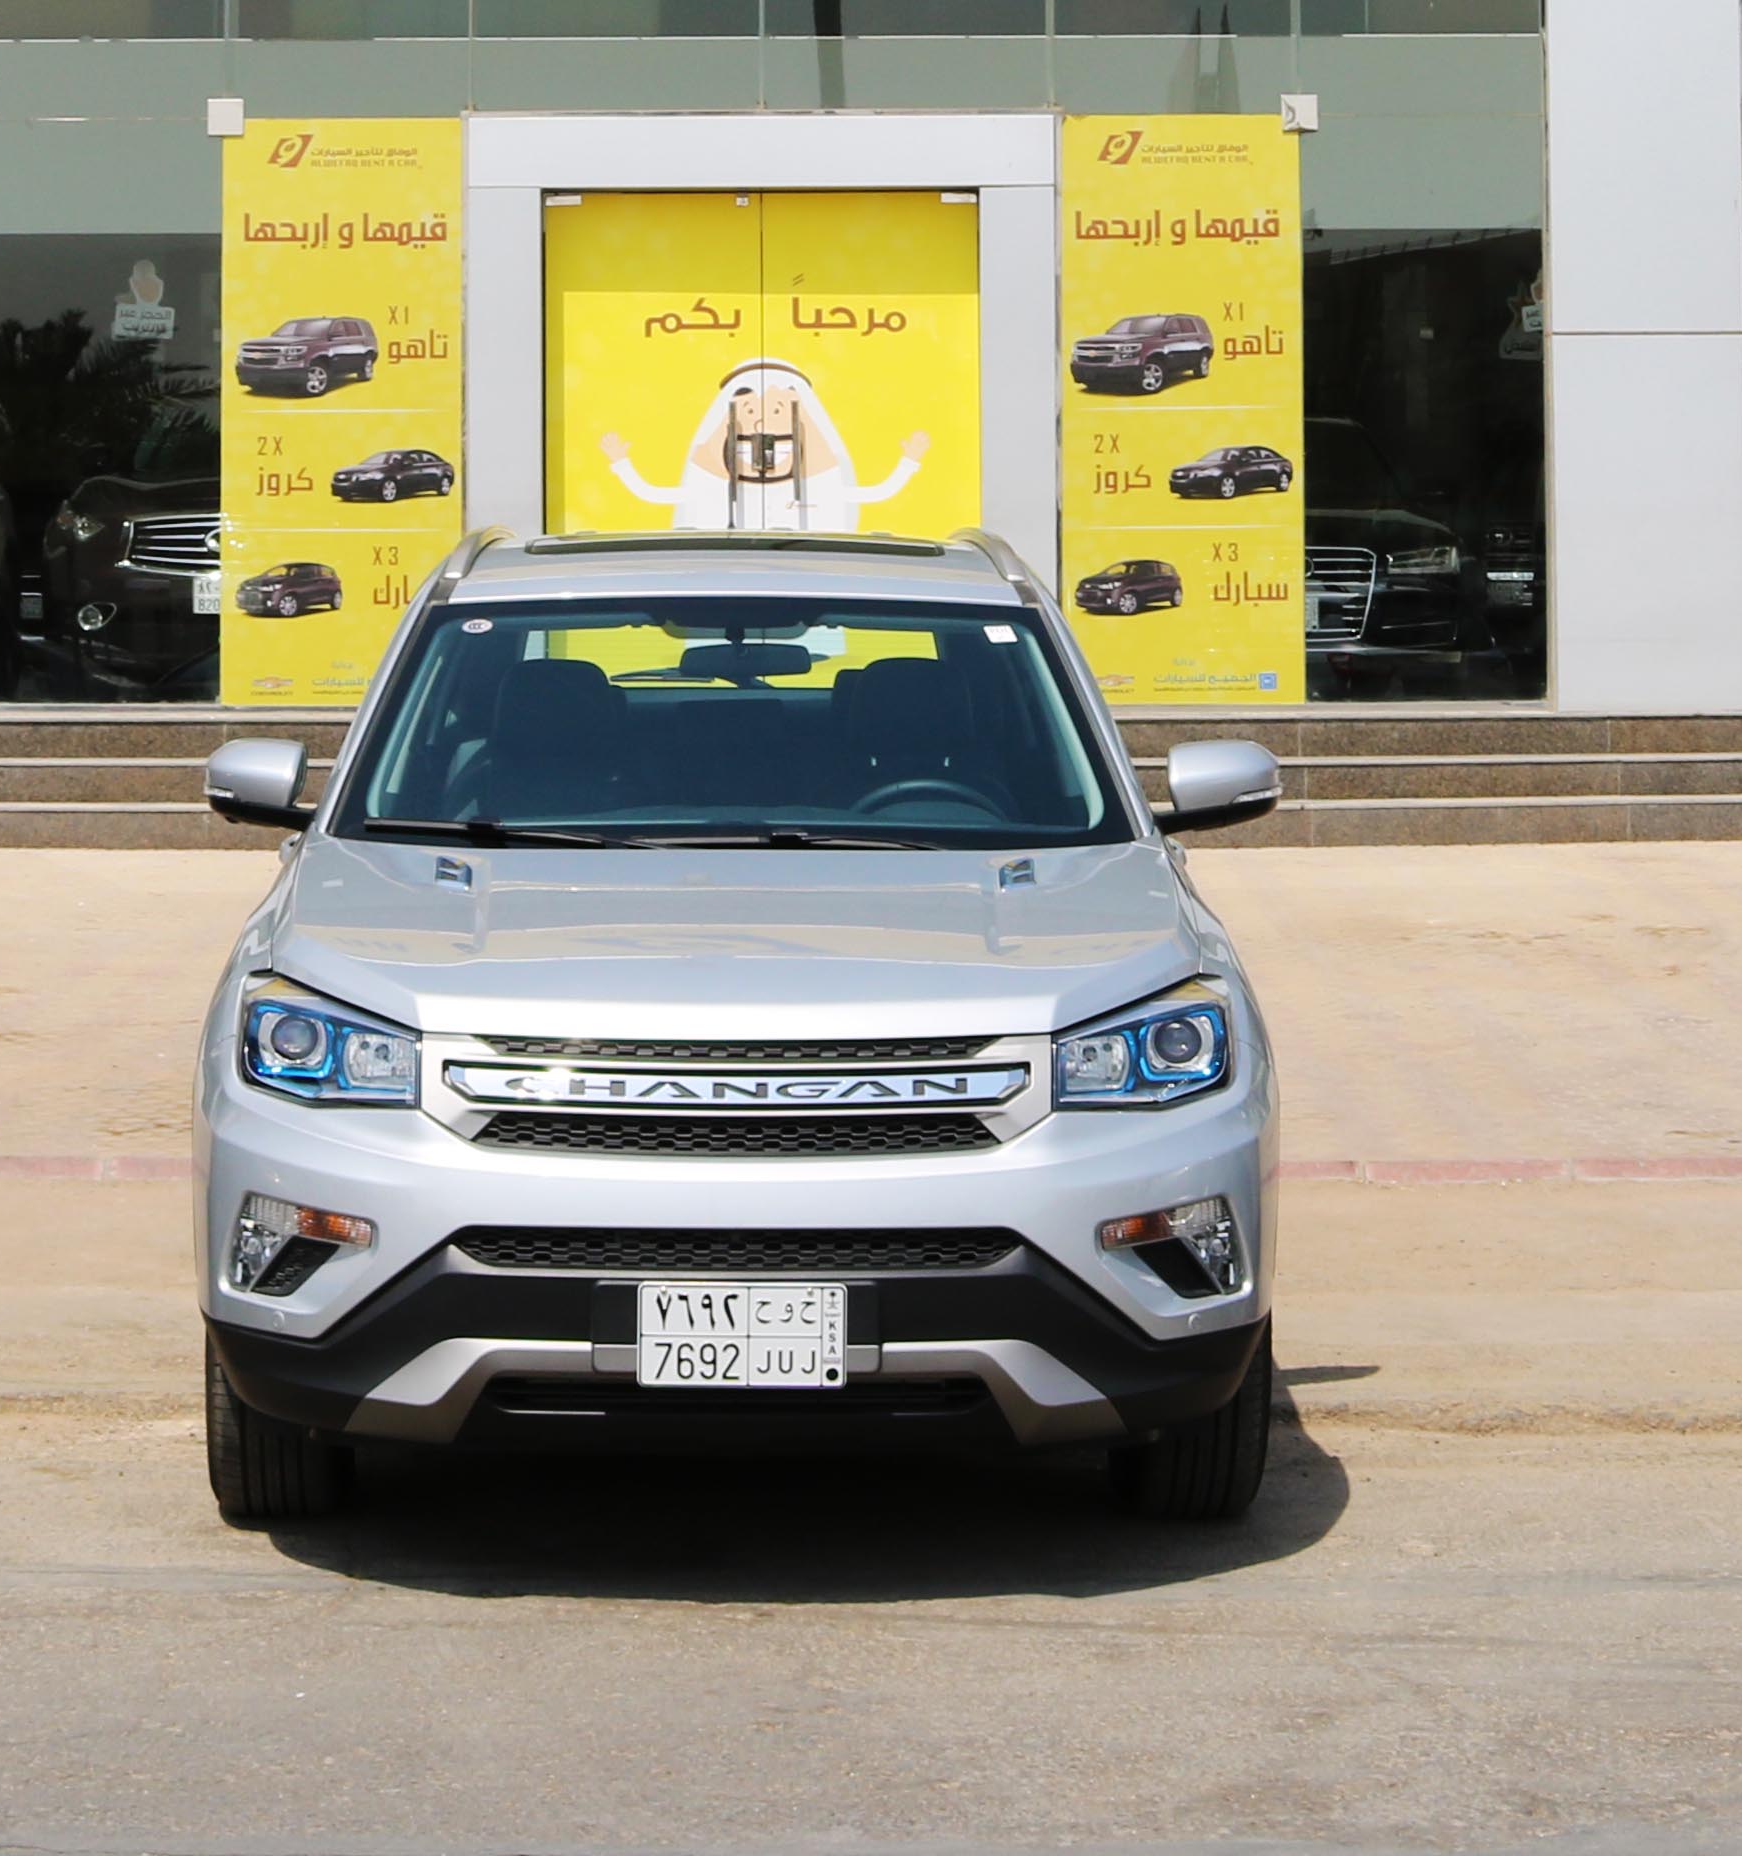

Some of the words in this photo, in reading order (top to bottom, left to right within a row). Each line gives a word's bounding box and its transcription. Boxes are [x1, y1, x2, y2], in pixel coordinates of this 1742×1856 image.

[337, 222, 354, 249] و
[362, 211, 447, 249] قيمها
[1170, 218, 1187, 245] و
[1194, 208, 1280, 245] قيمها
[388, 305, 398, 325] X
[644, 296, 742, 338] بكم
[1223, 302, 1233, 321] X
[388, 328, 448, 365] تاهو
[1223, 324, 1284, 361] تاهو
[257, 436, 268, 456] 2
[273, 436, 283, 456] X
[1093, 433, 1104, 454] 2
[1109, 433, 1121, 454] X
[255, 466, 314, 497] كروز
[1093, 464, 1152, 494] كروز
[372, 546, 382, 566] X
[388, 546, 399, 566] 3
[1212, 542, 1222, 562] X
[1227, 542, 1239, 562] 3
[373, 574, 411, 610] ارك
[1213, 570, 1288, 608] سبارك
[503, 1074, 969, 1100] CHANGAN
[655, 1293, 740, 1331] ٧٦٩٢
[654, 1342, 740, 1381] 7692
